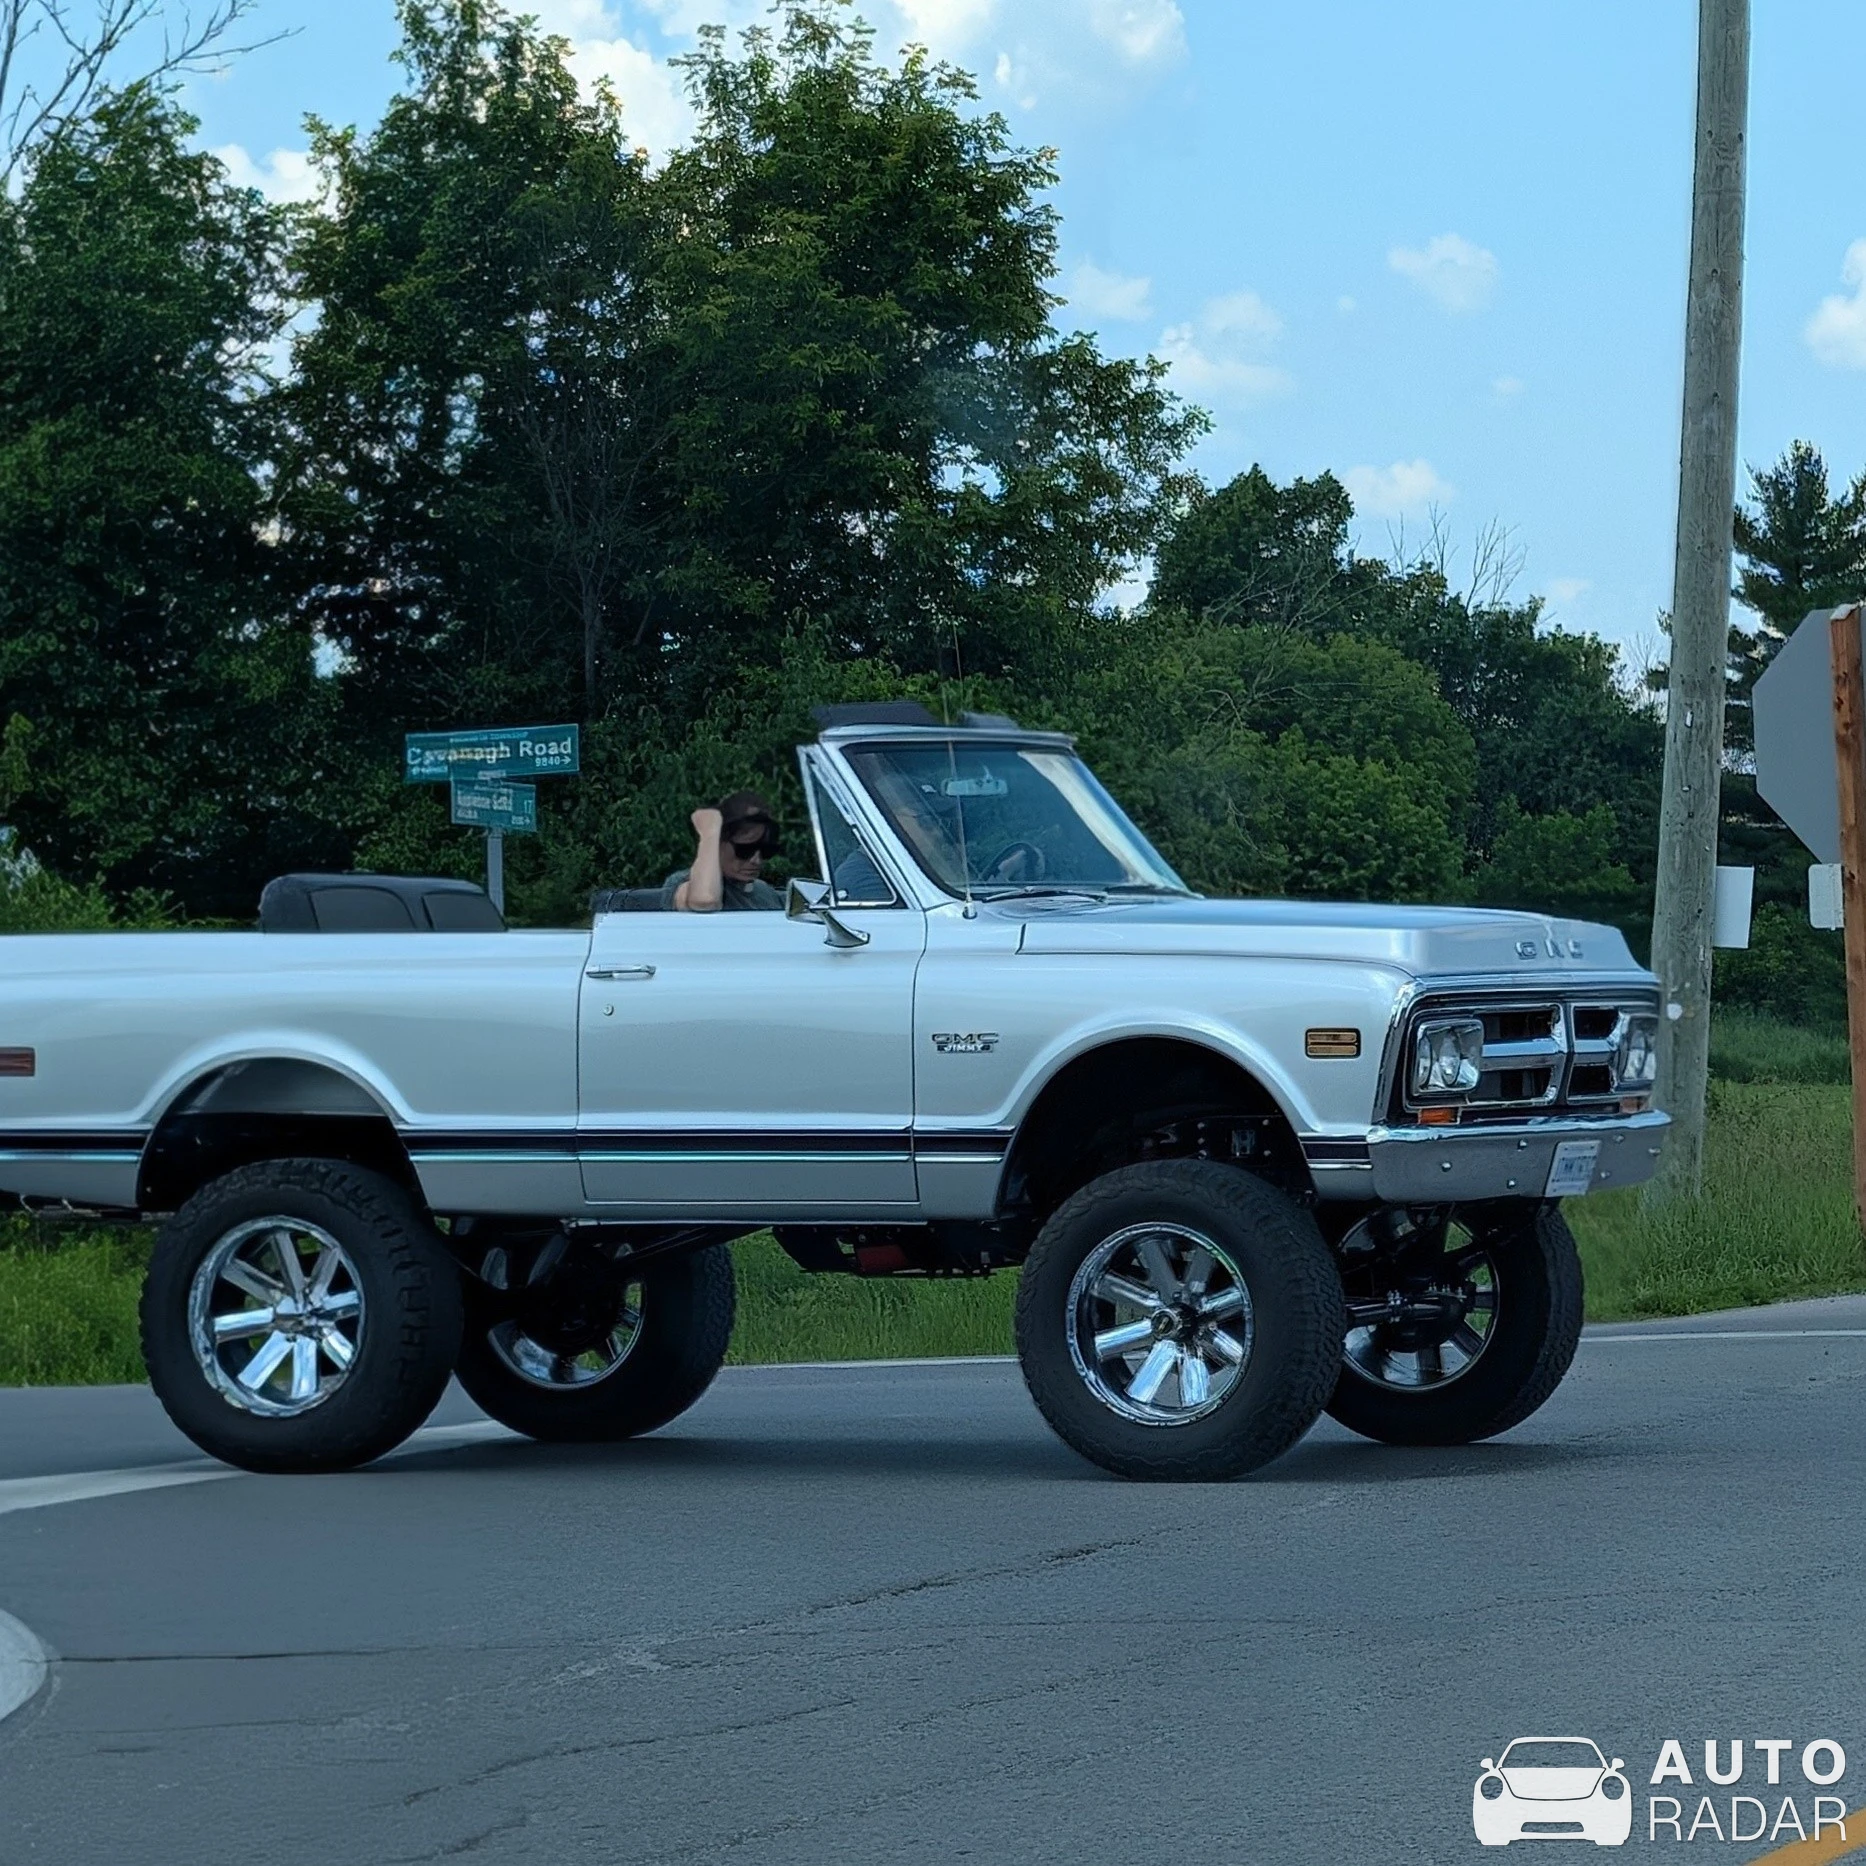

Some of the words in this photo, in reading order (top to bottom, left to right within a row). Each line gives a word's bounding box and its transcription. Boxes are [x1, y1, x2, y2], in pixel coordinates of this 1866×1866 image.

[519, 737, 572, 758] Road
[931, 1032, 999, 1044] GMC
[943, 1043, 984, 1052] JIMMY
